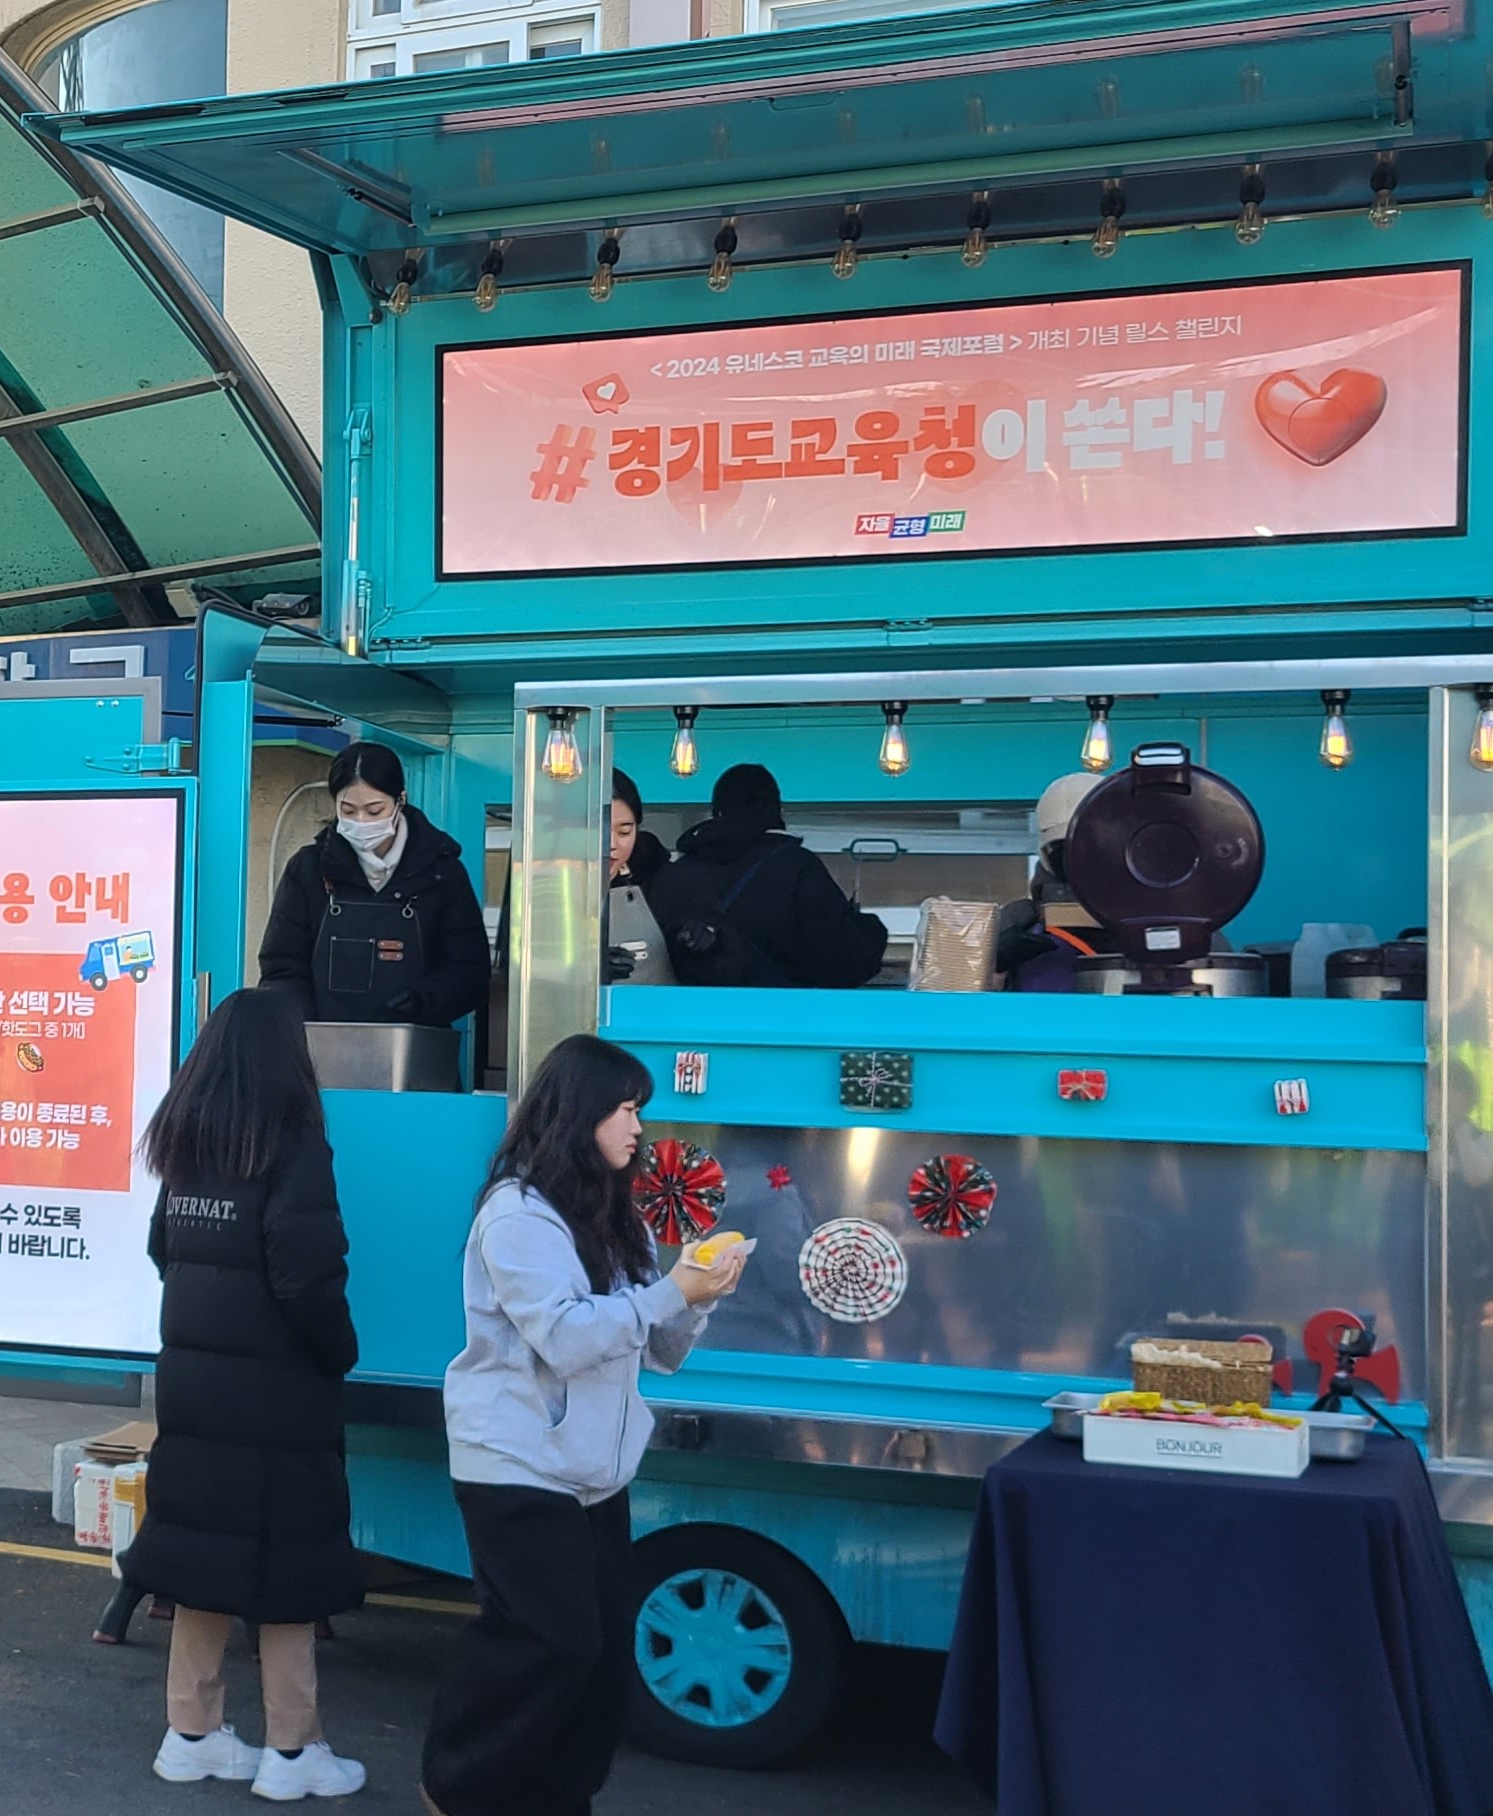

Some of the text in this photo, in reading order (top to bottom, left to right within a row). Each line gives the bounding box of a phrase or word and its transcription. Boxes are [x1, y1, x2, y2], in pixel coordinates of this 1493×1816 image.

[666, 356, 720, 379] 2024
[724, 350, 804, 374] 유네스코
[808, 344, 869, 369] 교육의
[874, 340, 916, 362] 미래
[920, 333, 1004, 358] 국제포럼
[1027, 328, 1070, 351] 개최
[1076, 324, 1119, 347] 기념
[1125, 322, 1169, 344] 릴스
[1174, 315, 1242, 340] 챌린지
[893, 519, 926, 536] 균형
[929, 513, 962, 529] 미래
[48, 872, 130, 924] 안내
[8, 992, 49, 1015] 선택
[53, 991, 95, 1016] 가능
[44, 1022, 59, 1038] 중
[36, 1103, 87, 1124] 종료된
[89, 1105, 112, 1127] 후,
[10, 1128, 42, 1148] 이용
[46, 1129, 81, 1149] 가능
[0, 1201, 19, 1225] 수
[23, 1205, 82, 1230] 있도록
[8, 1233, 90, 1260] 바랍니다.
[1156, 1439, 1223, 1454] BONJOUR
